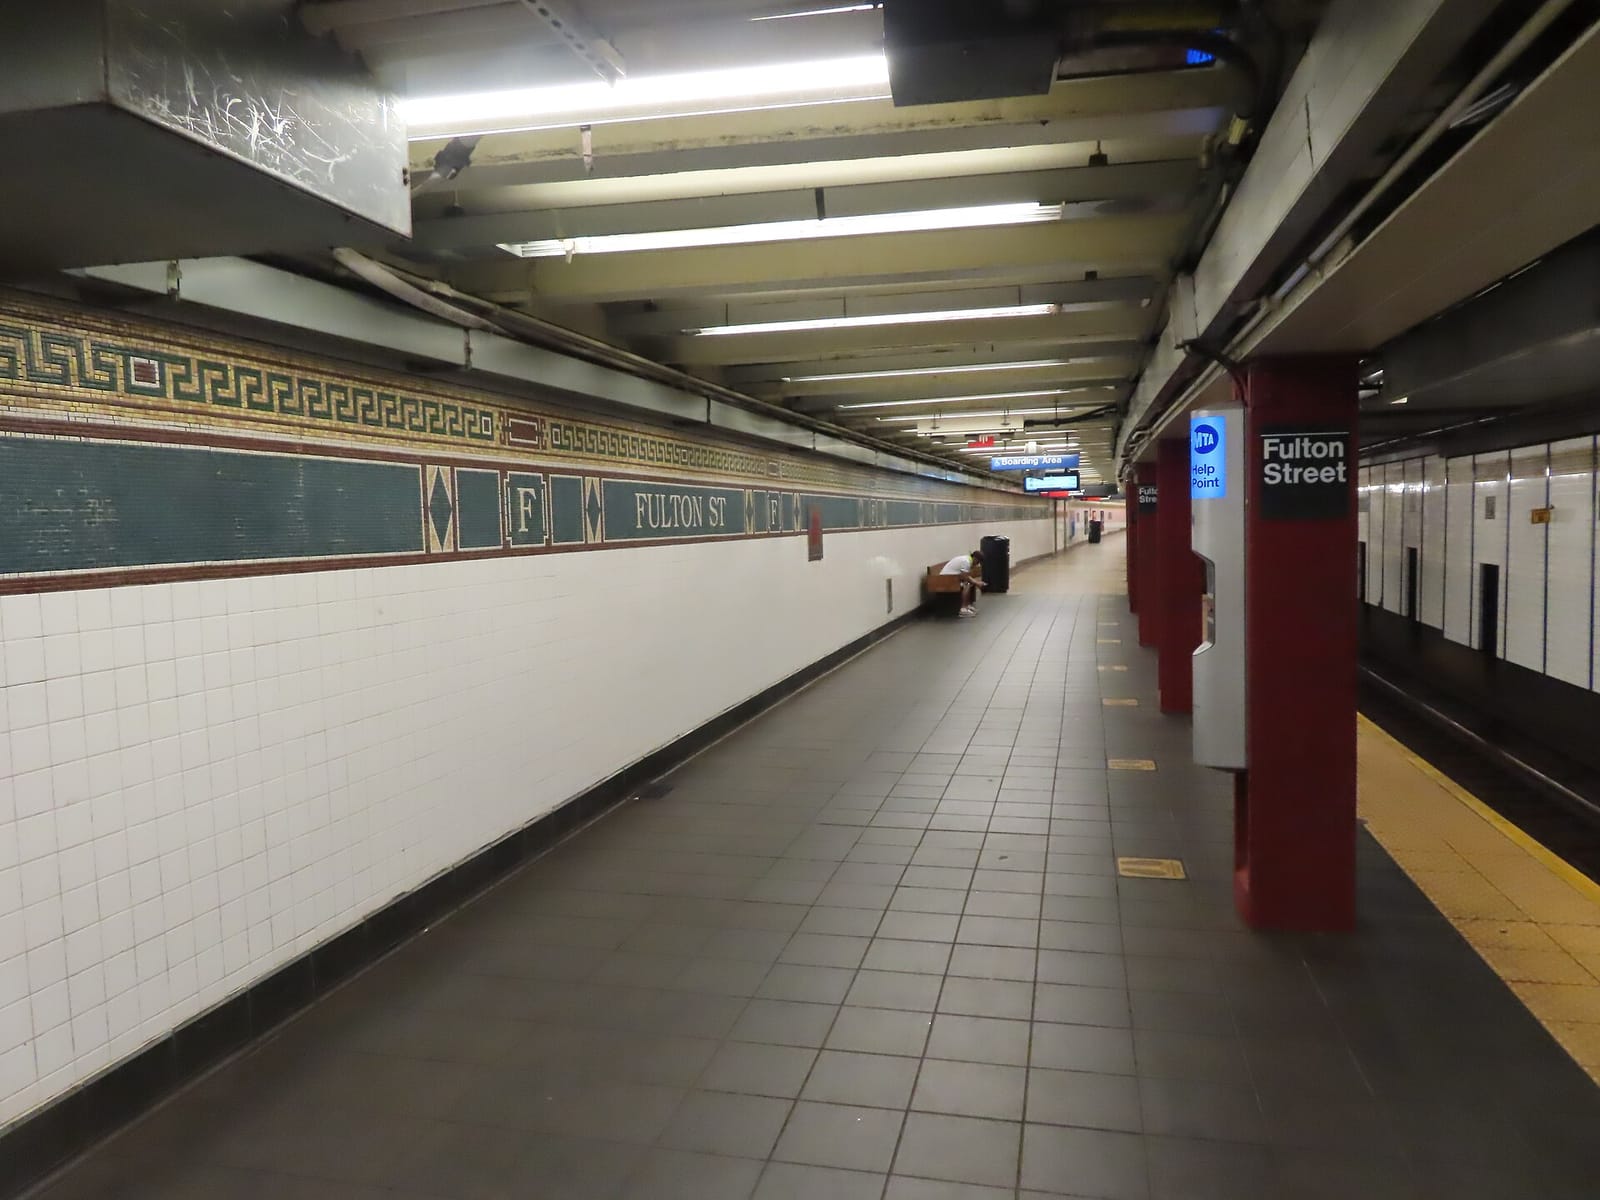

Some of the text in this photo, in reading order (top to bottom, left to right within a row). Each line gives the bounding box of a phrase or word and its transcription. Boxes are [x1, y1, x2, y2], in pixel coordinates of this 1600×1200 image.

[1195, 431, 1214, 448] MTA
[1263, 437, 1344, 460] Fulton
[1001, 456, 1062, 466] Boarding Area
[1192, 463, 1215, 476] Help
[1192, 477, 1220, 489] Point
[1263, 461, 1347, 485] Street
[516, 487, 537, 532] F
[634, 492, 727, 529] FULTON ST
